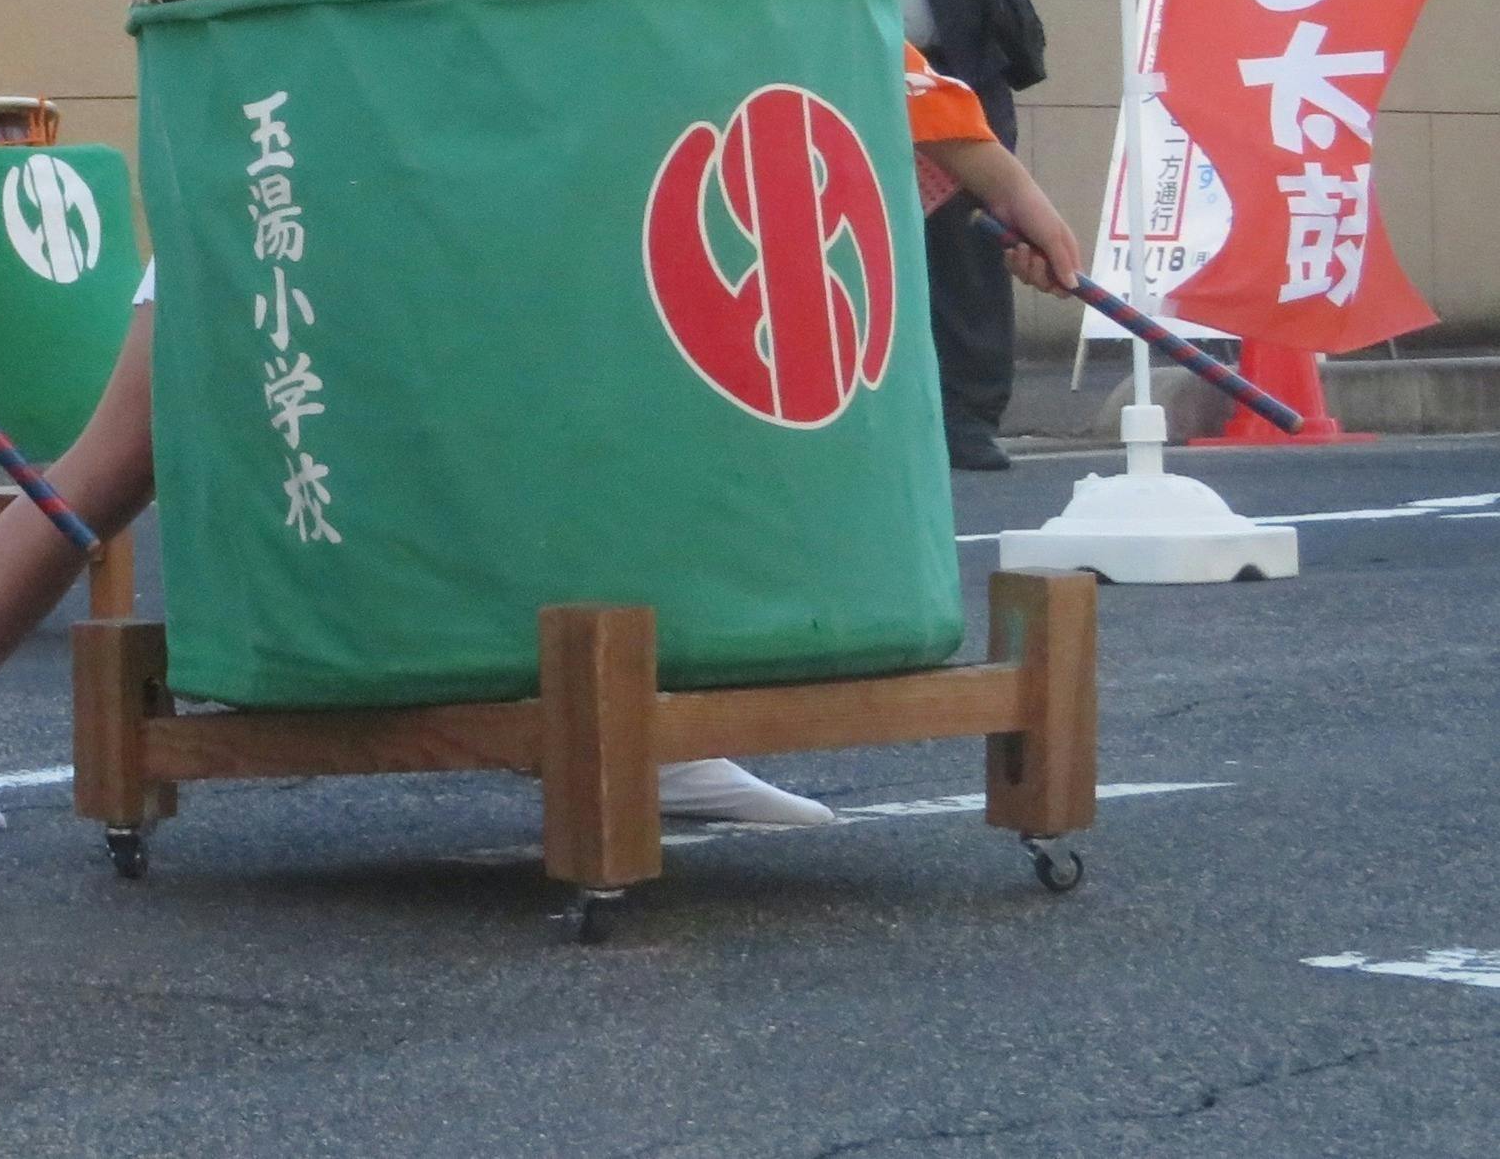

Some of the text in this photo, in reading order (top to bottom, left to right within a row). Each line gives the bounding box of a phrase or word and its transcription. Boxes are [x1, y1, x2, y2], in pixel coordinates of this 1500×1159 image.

[243, 90, 343, 544] 玉湯小学校
